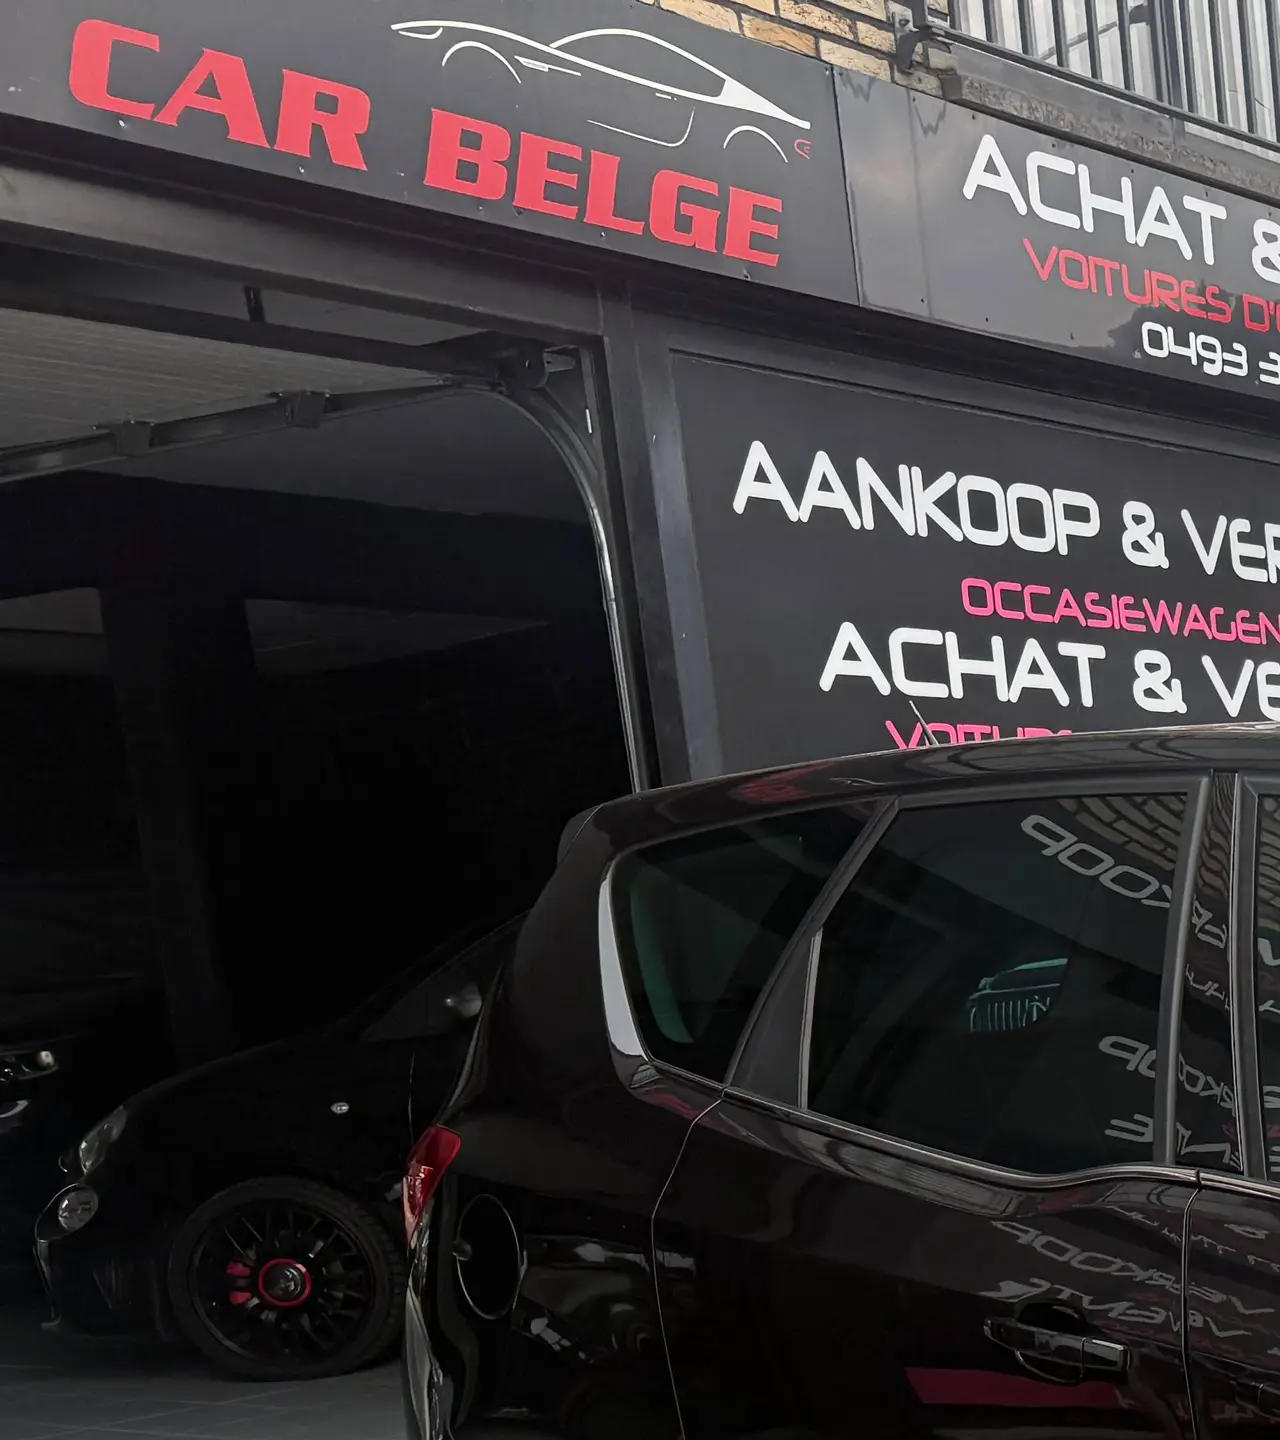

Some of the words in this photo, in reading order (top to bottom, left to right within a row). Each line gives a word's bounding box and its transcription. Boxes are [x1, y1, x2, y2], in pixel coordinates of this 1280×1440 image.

[69, 19, 371, 170] CAR
[423, 108, 783, 267] BELGE
[962, 133, 1227, 266] ACHAT
[1023, 237, 1232, 324] VOITURES
[1141, 321, 1248, 377] 0493
[733, 440, 1101, 555] AANKOOP
[1122, 502, 1168, 569] &
[819, 621, 1107, 707] ACHAT
[1132, 649, 1187, 714] &
